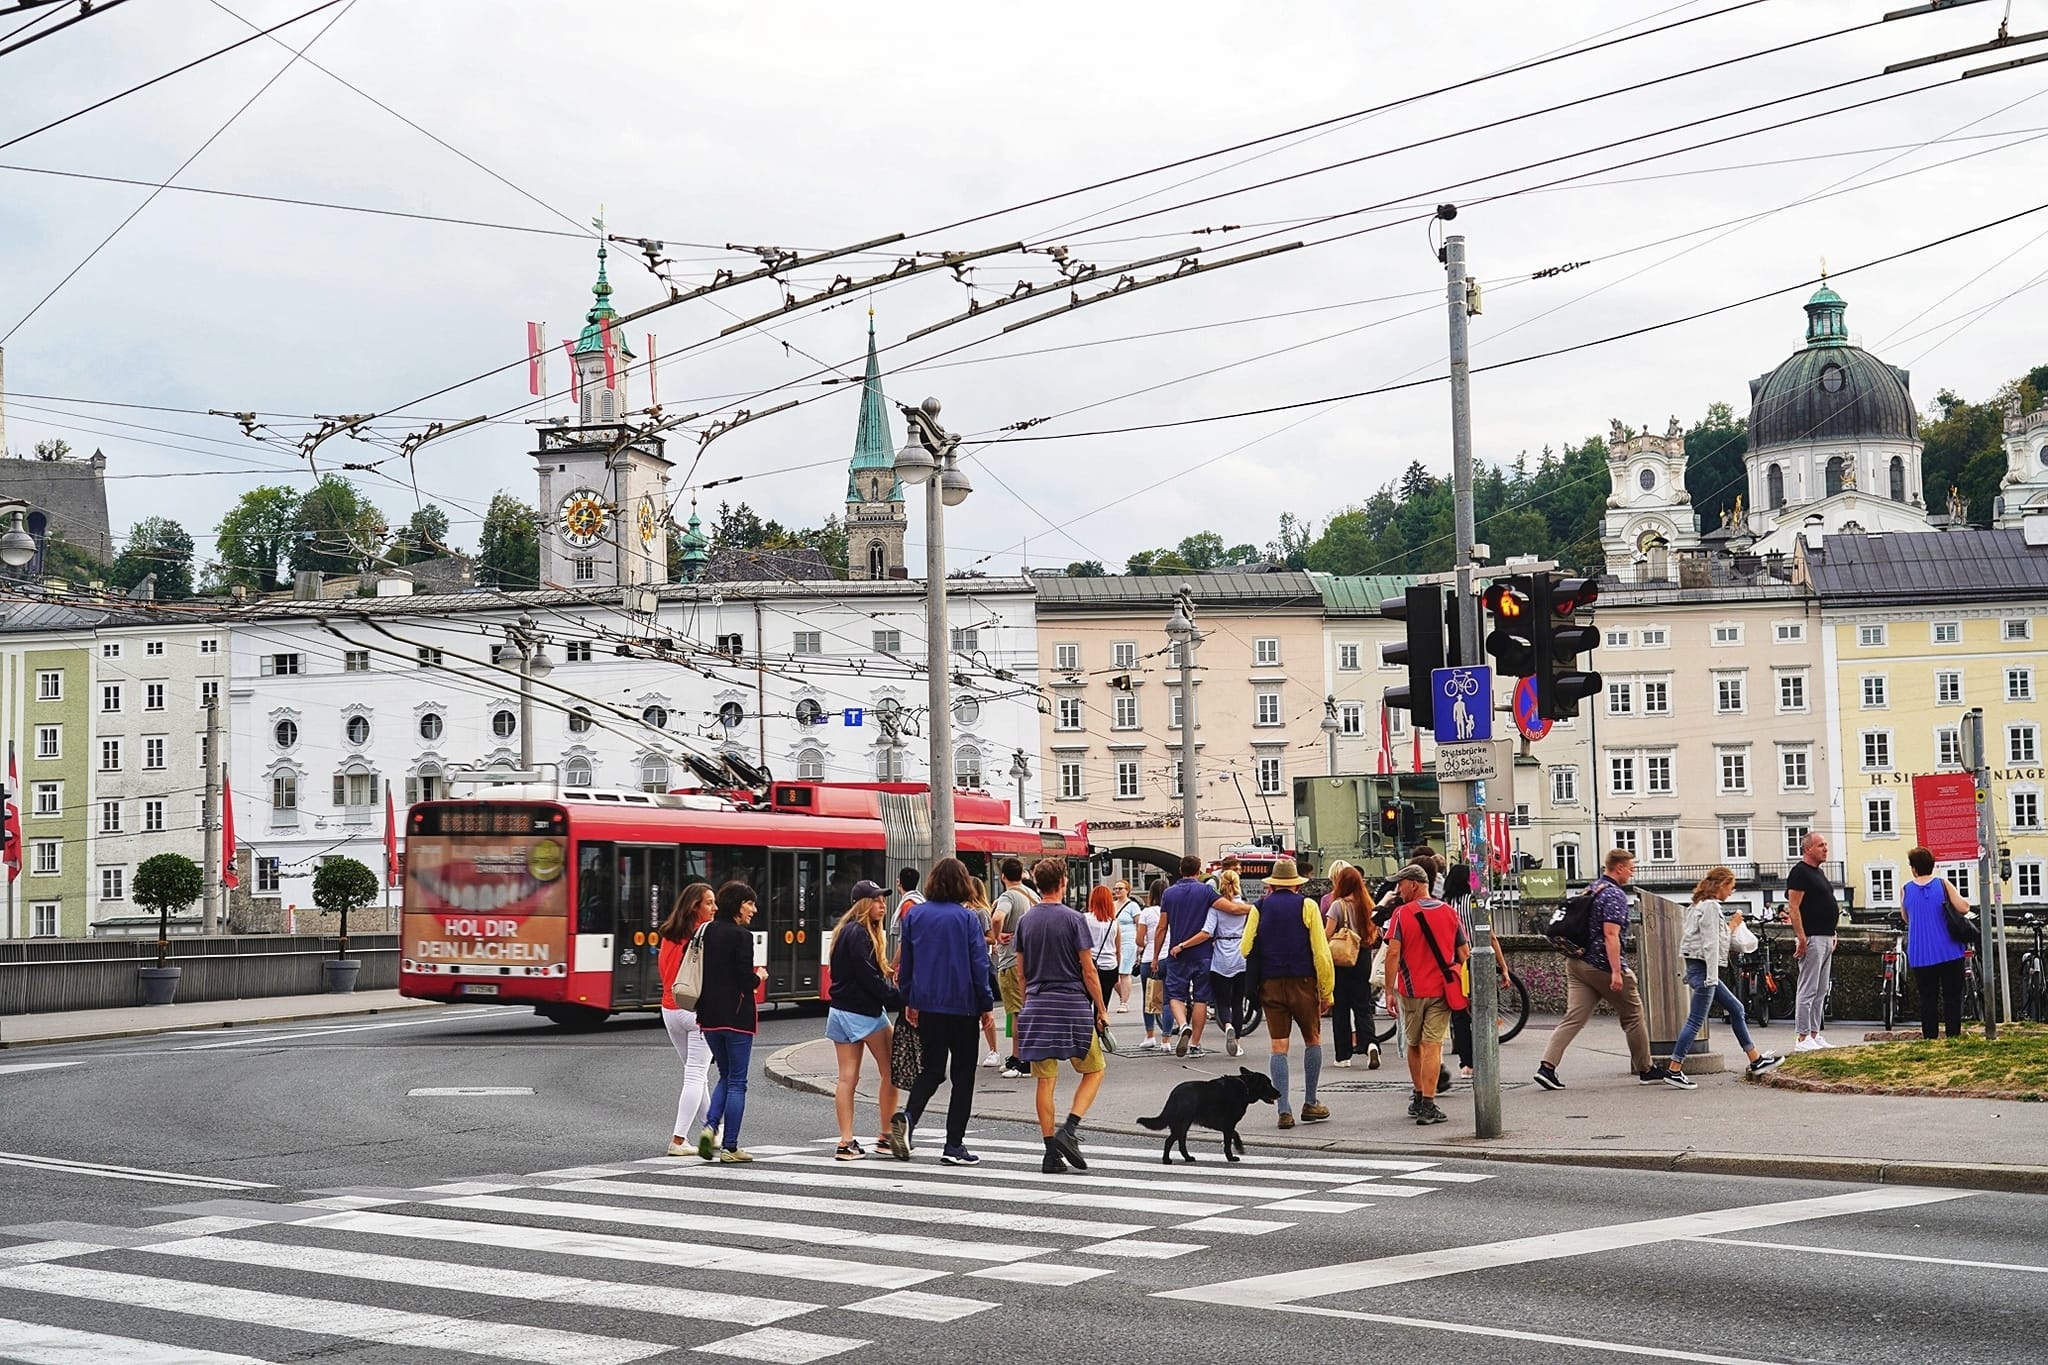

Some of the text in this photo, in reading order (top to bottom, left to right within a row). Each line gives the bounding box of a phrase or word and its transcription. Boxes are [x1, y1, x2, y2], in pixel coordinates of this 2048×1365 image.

[1526, 728, 1545, 739] ENDE
[1087, 821, 1131, 831] ONTOBEL
[445, 919, 518, 937] HOL DIR
[418, 940, 459, 958] DEIN
